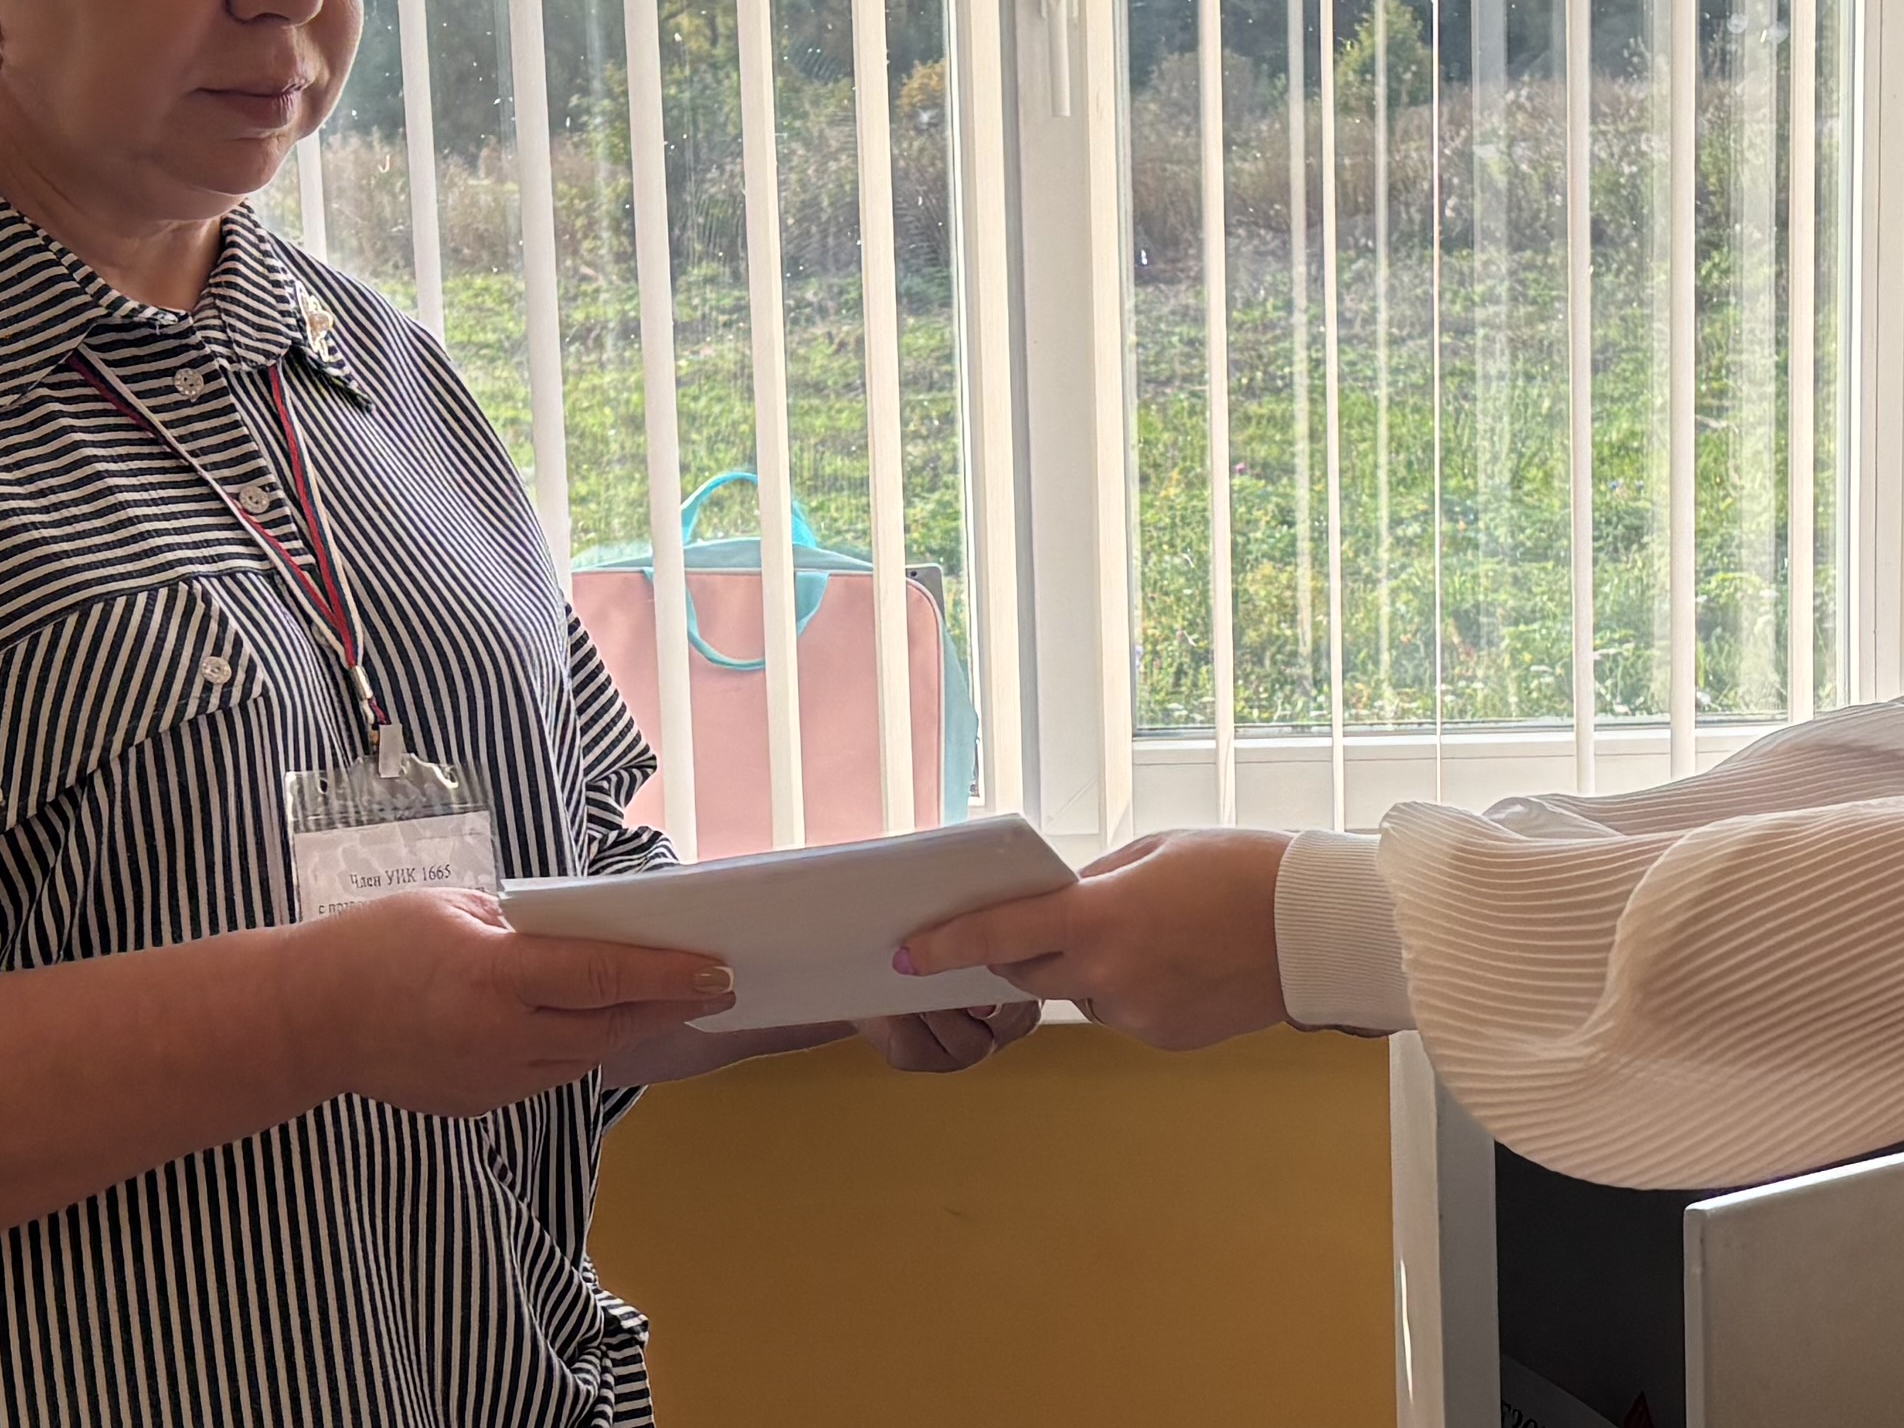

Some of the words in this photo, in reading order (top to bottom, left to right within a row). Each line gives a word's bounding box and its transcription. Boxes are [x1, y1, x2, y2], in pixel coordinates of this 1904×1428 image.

[350, 874, 381, 888] Член
[385, 867, 416, 886] УИК
[422, 864, 451, 881] 1665
